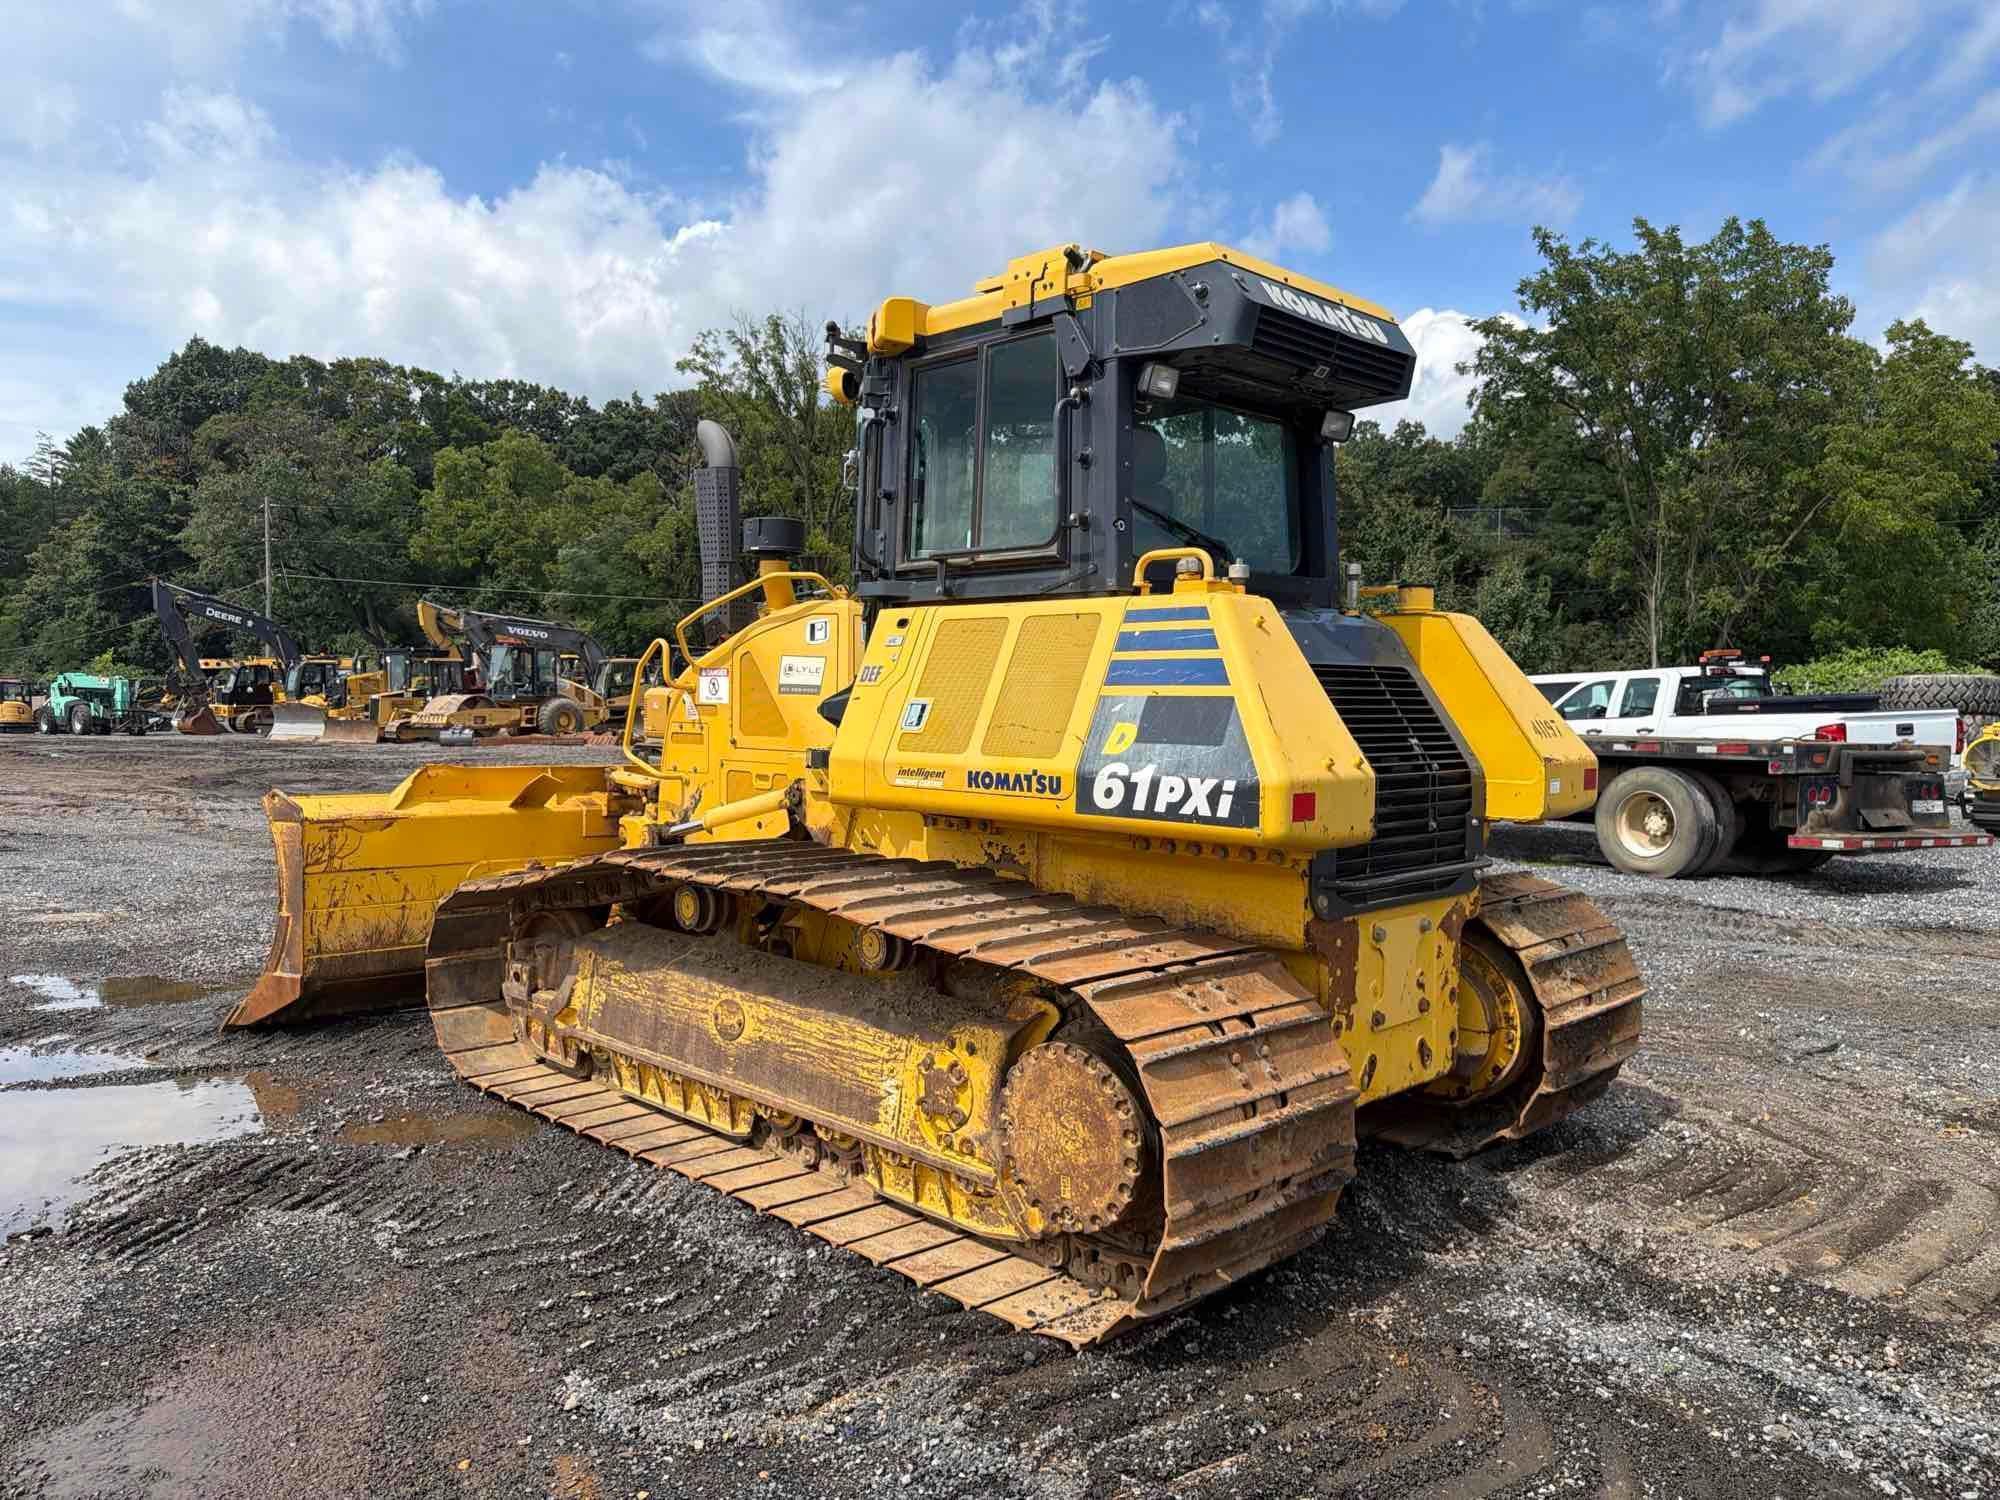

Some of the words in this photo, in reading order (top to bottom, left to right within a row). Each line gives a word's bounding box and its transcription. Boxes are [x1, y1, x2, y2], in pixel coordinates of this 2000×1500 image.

[1260, 280, 1388, 344] KOMATSU
[206, 607, 242, 624] DEERE
[507, 626, 548, 639] VOLVO
[860, 665, 884, 682] DEF
[1102, 722, 1138, 755] D
[897, 766, 946, 781] intelligent
[967, 769, 1062, 795] KOMATSU
[1092, 762, 1237, 818] 61PXi
